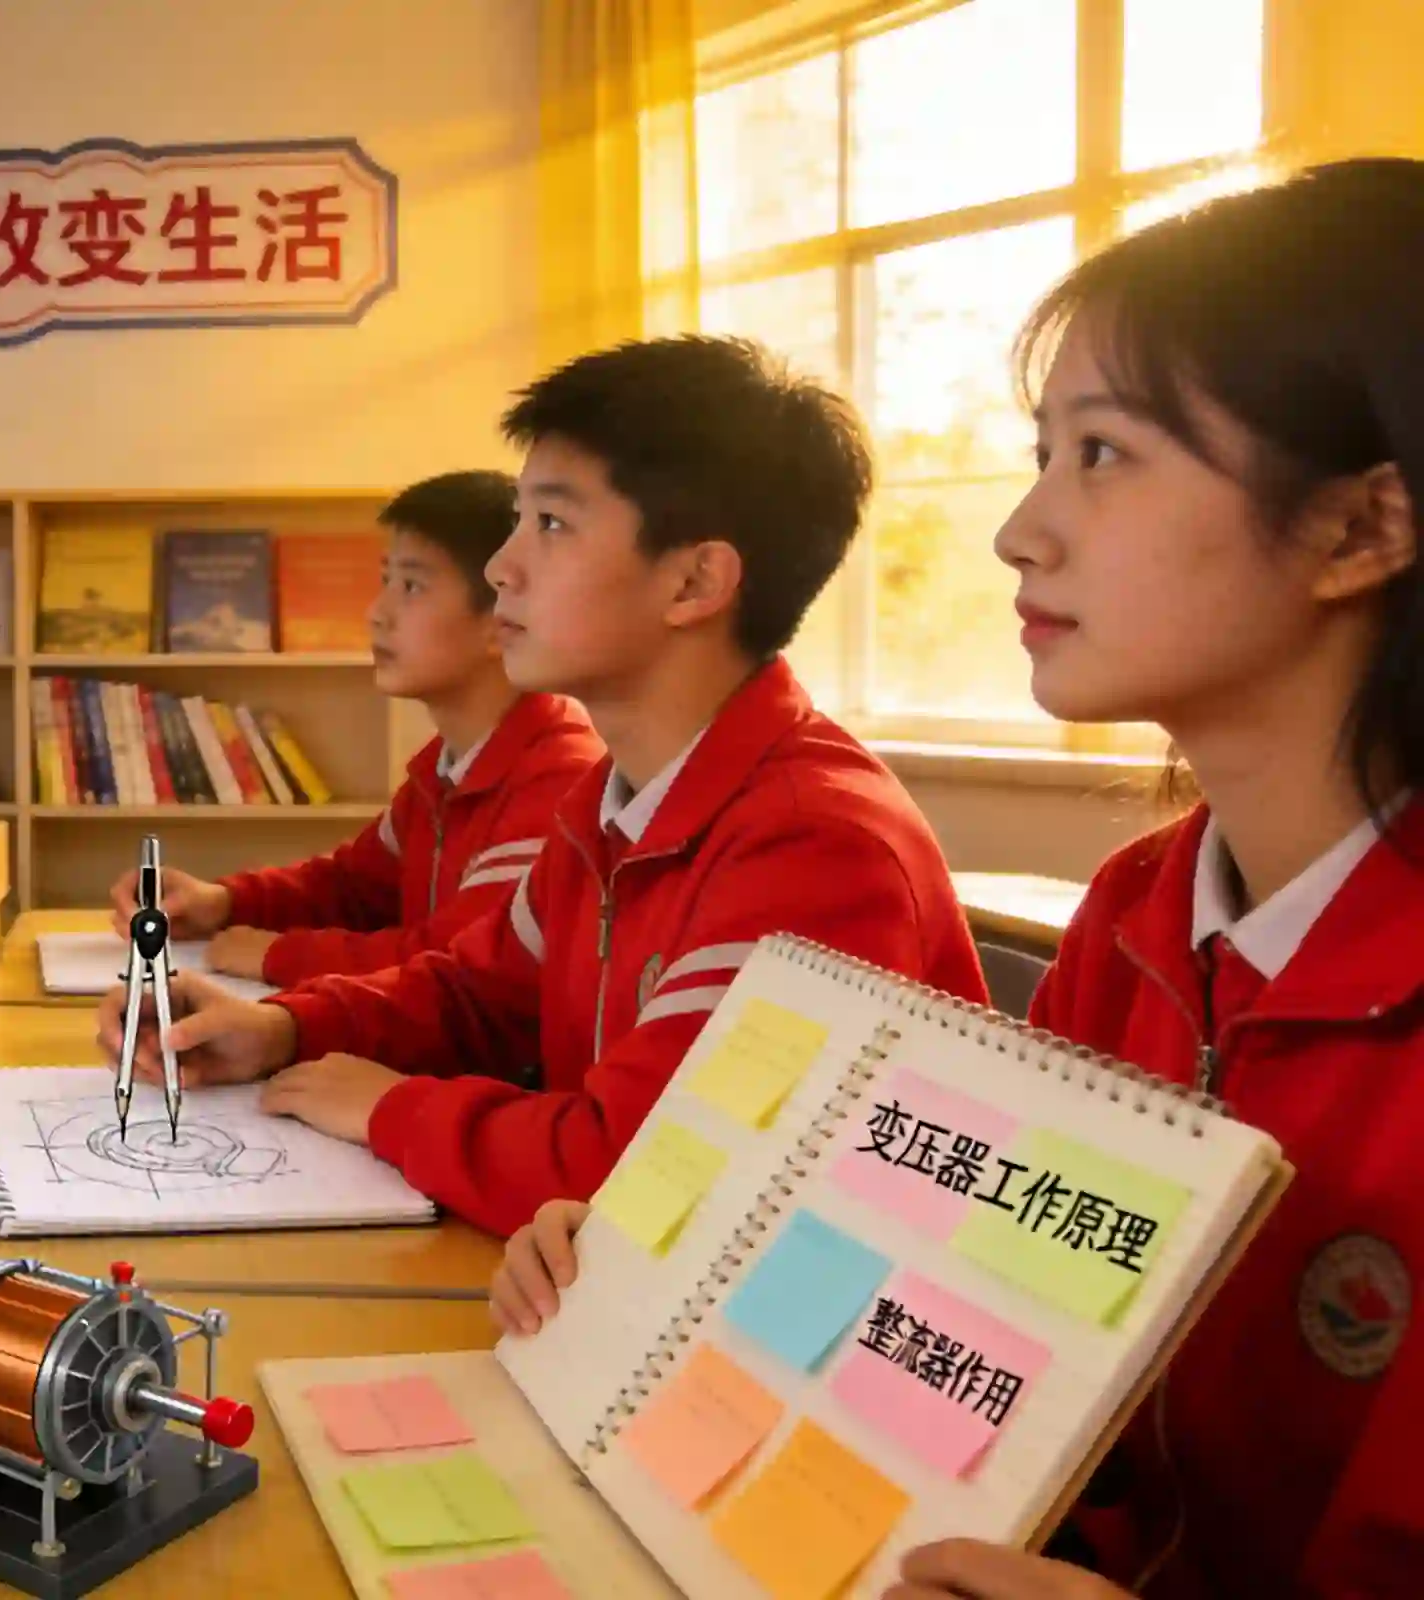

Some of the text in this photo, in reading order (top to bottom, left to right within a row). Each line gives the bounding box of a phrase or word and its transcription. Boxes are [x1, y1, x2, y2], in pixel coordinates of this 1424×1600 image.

[856, 1099, 1159, 1274] 变压器工作原理
[857, 1297, 1024, 1427] 整流器作用
